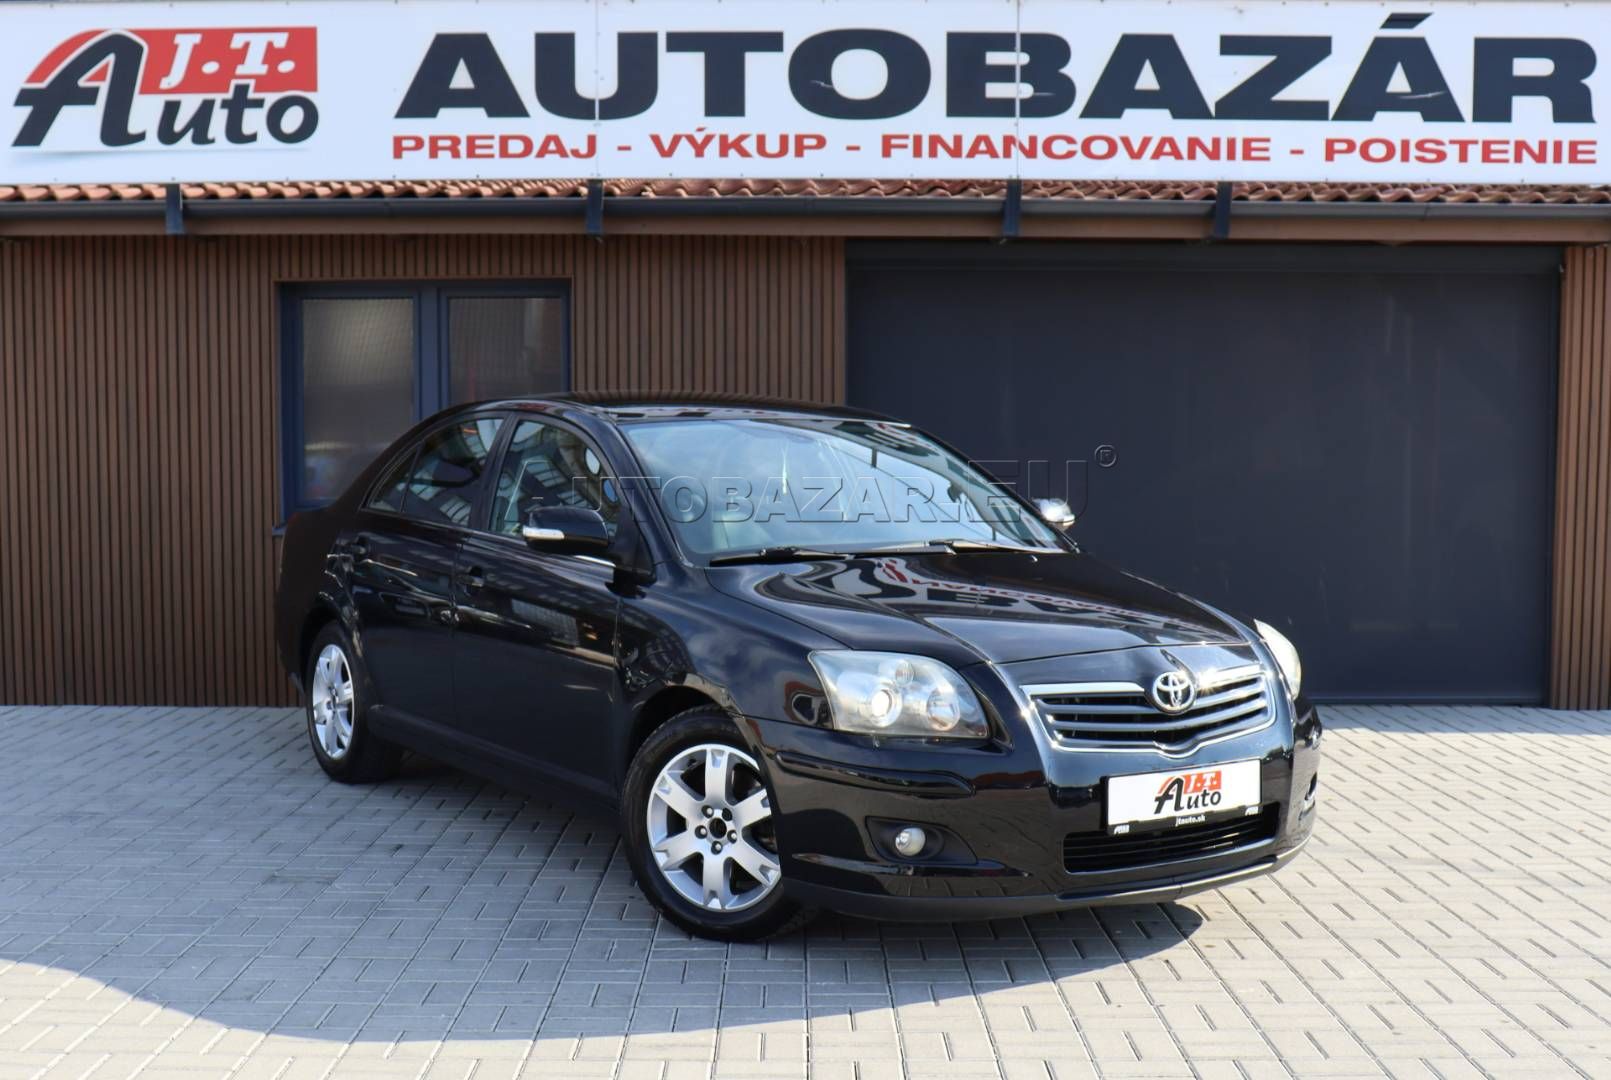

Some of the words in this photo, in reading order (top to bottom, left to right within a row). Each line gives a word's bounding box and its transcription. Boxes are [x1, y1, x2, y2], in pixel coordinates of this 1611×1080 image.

[11, 32, 320, 148] Auto
[158, 31, 296, 90] J.T.
[394, 12, 1598, 123] AUTOBAZÁR
[393, 133, 597, 160] PREDAJ
[650, 127, 827, 159] VÝKUP
[881, 133, 1270, 162] FINANCOVANIE
[1325, 136, 1597, 165] POISTENIE
[1153, 776, 1222, 815] Auto
